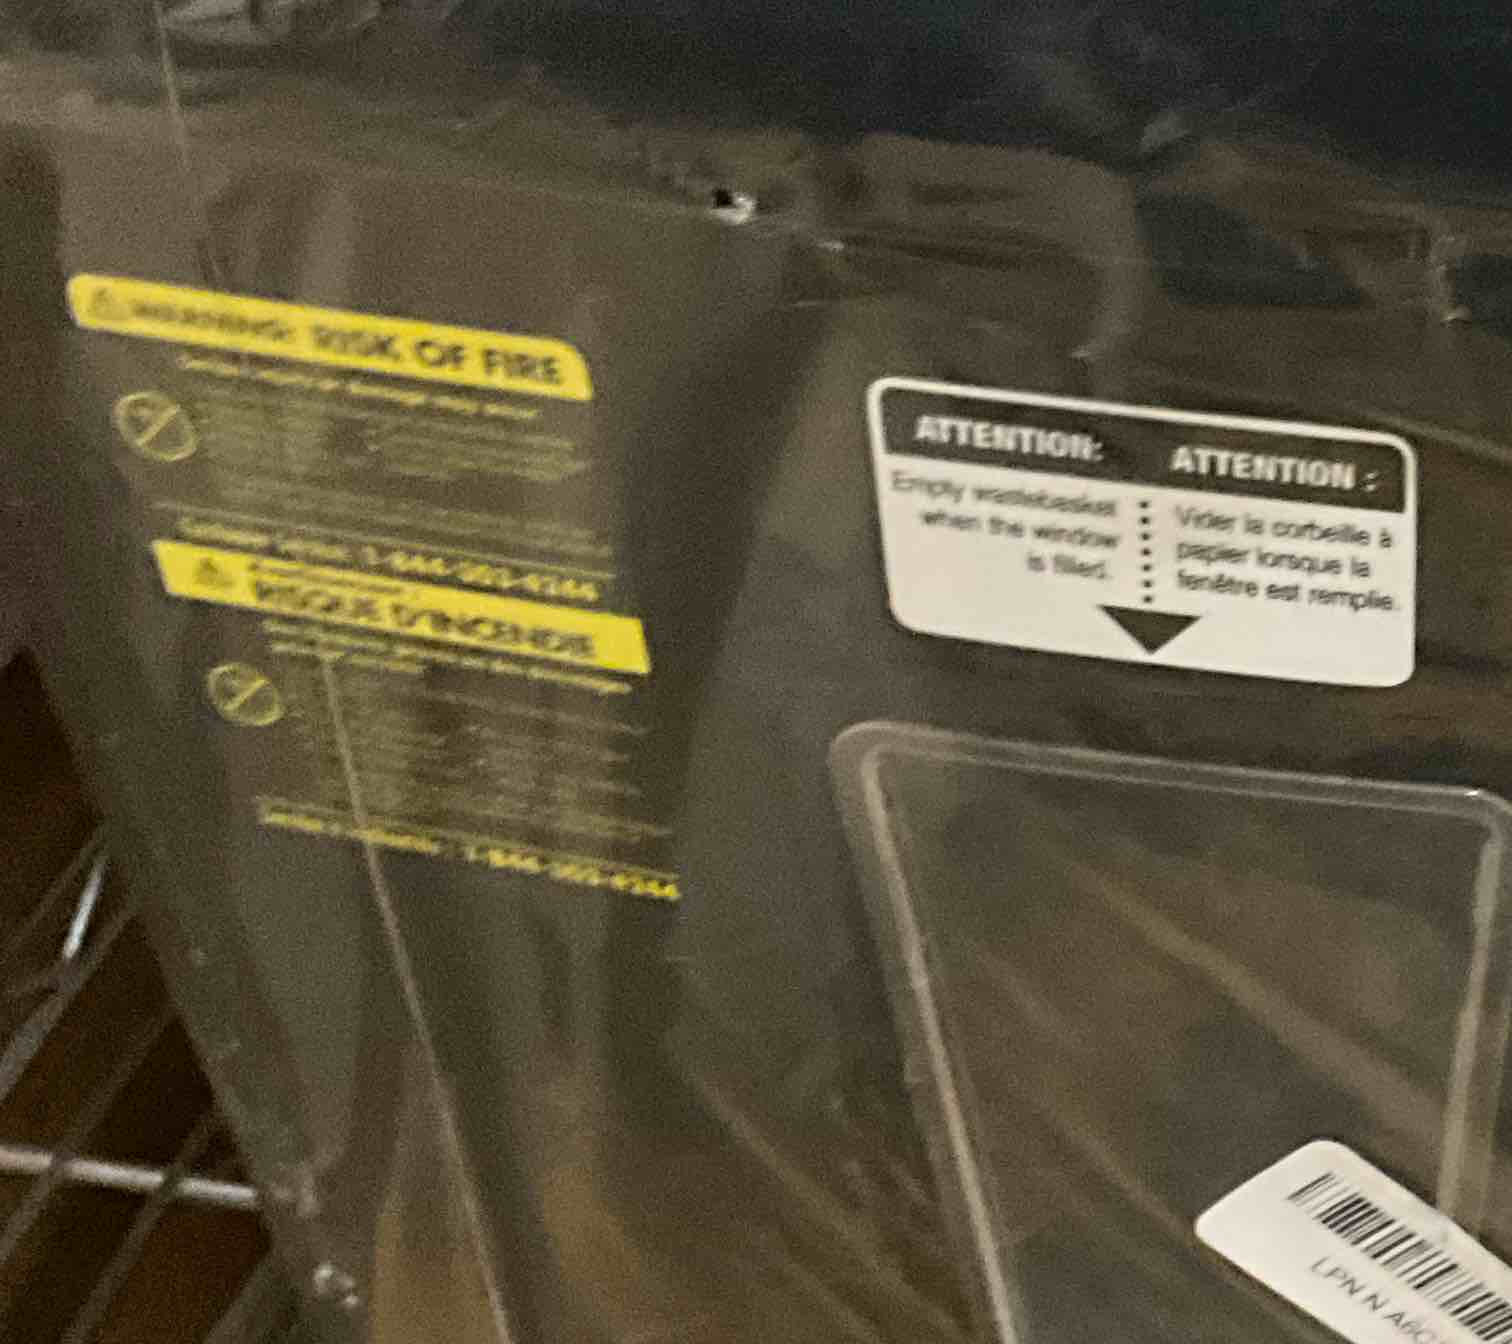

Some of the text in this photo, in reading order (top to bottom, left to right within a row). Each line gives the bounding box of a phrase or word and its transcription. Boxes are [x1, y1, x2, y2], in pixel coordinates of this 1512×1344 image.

[414, 339, 466, 371] OF
[482, 348, 563, 387] FIRE
[915, 414, 1105, 462] ATTENTION:
[920, 510, 1121, 549] when the window
[1175, 505, 1237, 531] Vider
[1027, 550, 1047, 573] is
[1265, 583, 1300, 602] est
